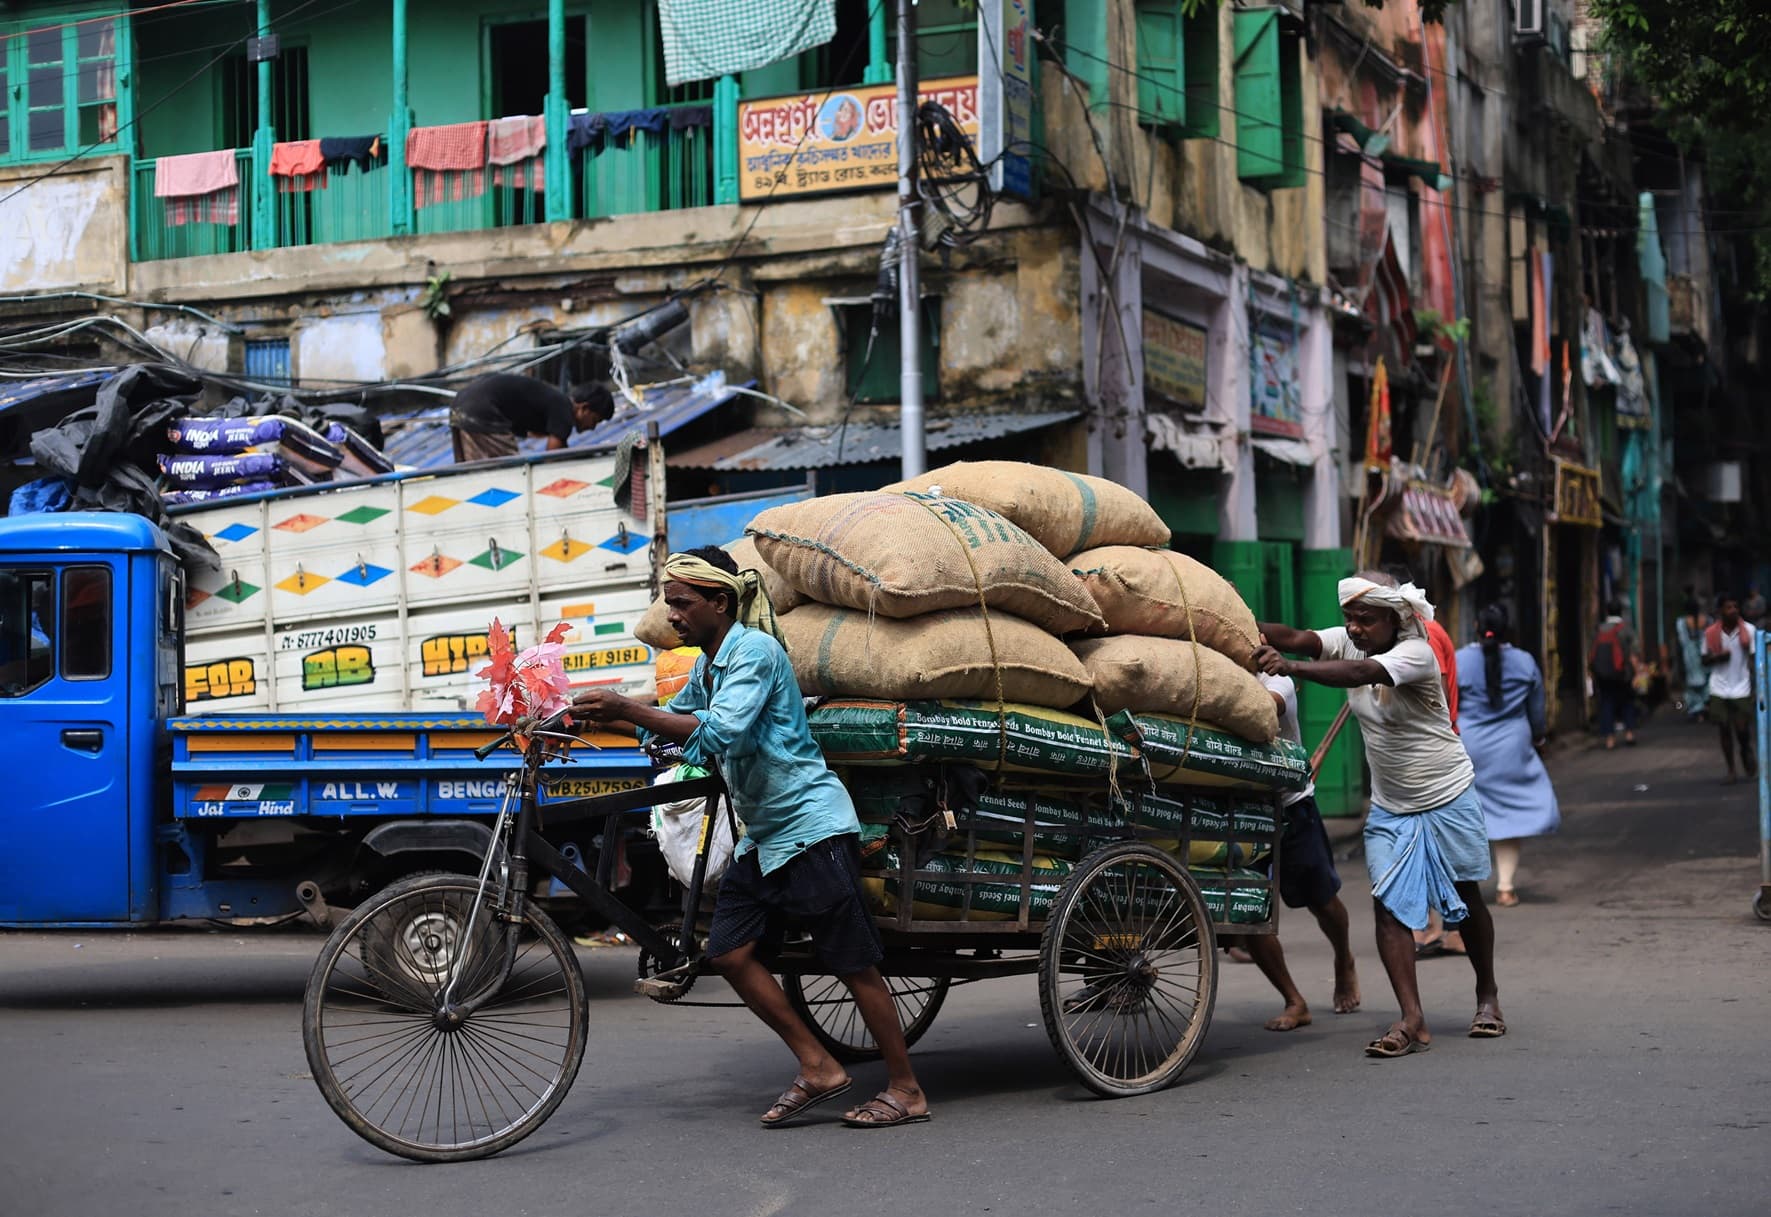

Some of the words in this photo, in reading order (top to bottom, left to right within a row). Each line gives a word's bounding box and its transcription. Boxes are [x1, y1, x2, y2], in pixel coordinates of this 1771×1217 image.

[185, 428, 219, 441] INDIA
[171, 460, 205, 475] INDIA
[421, 626, 517, 677] HIR
[185, 656, 256, 701] FOR
[917, 713, 949, 726] Bombay
[951, 715, 971, 726] Bold
[1025, 724, 1055, 739] Bombay
[1057, 731, 1074, 742] Bold
[1075, 734, 1101, 747] Fennel
[198, 801, 224, 816] Jai
[258, 801, 294, 816] Hind
[978, 890, 1002, 902] Seeds
